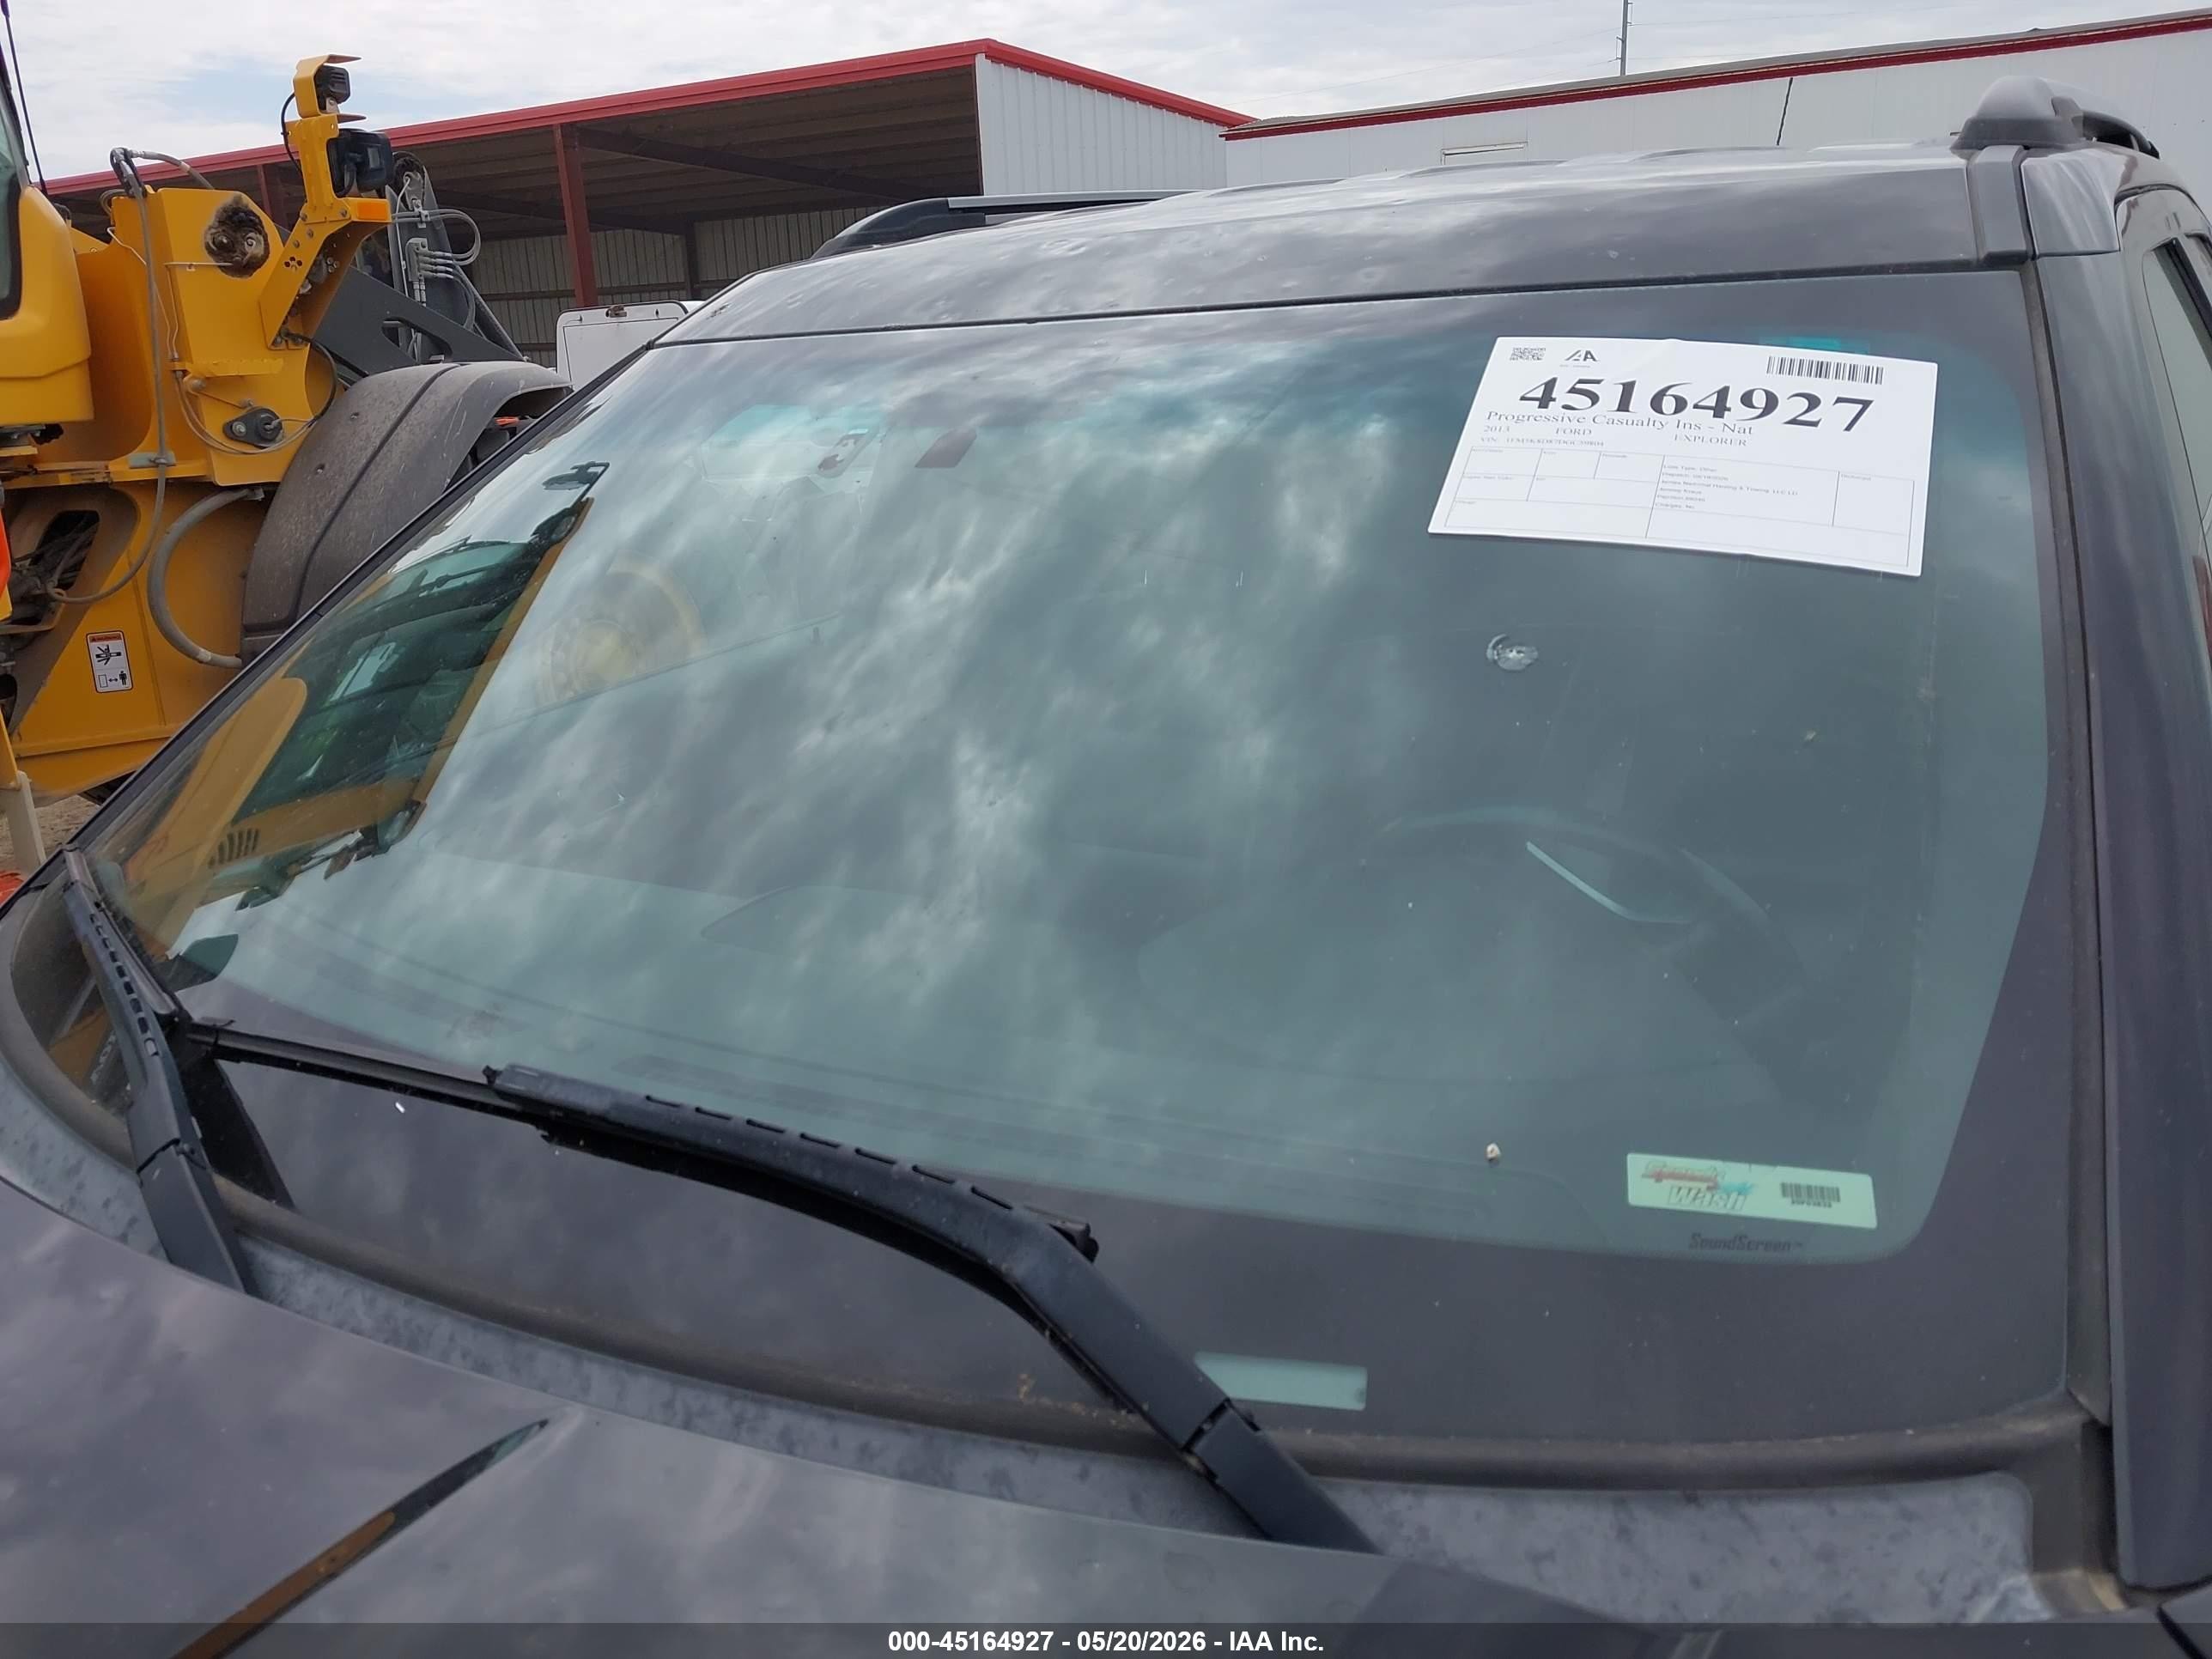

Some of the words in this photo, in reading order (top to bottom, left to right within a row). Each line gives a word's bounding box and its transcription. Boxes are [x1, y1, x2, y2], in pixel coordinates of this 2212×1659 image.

[1519, 376, 1875, 432] 45164927
[1486, 410, 1586, 423] Progressive
[1592, 414, 1668, 430] Casualty
[1676, 419, 1702, 431] Ins
[1722, 422, 1753, 434] Nat
[1674, 434, 1747, 447] EXPLORER
